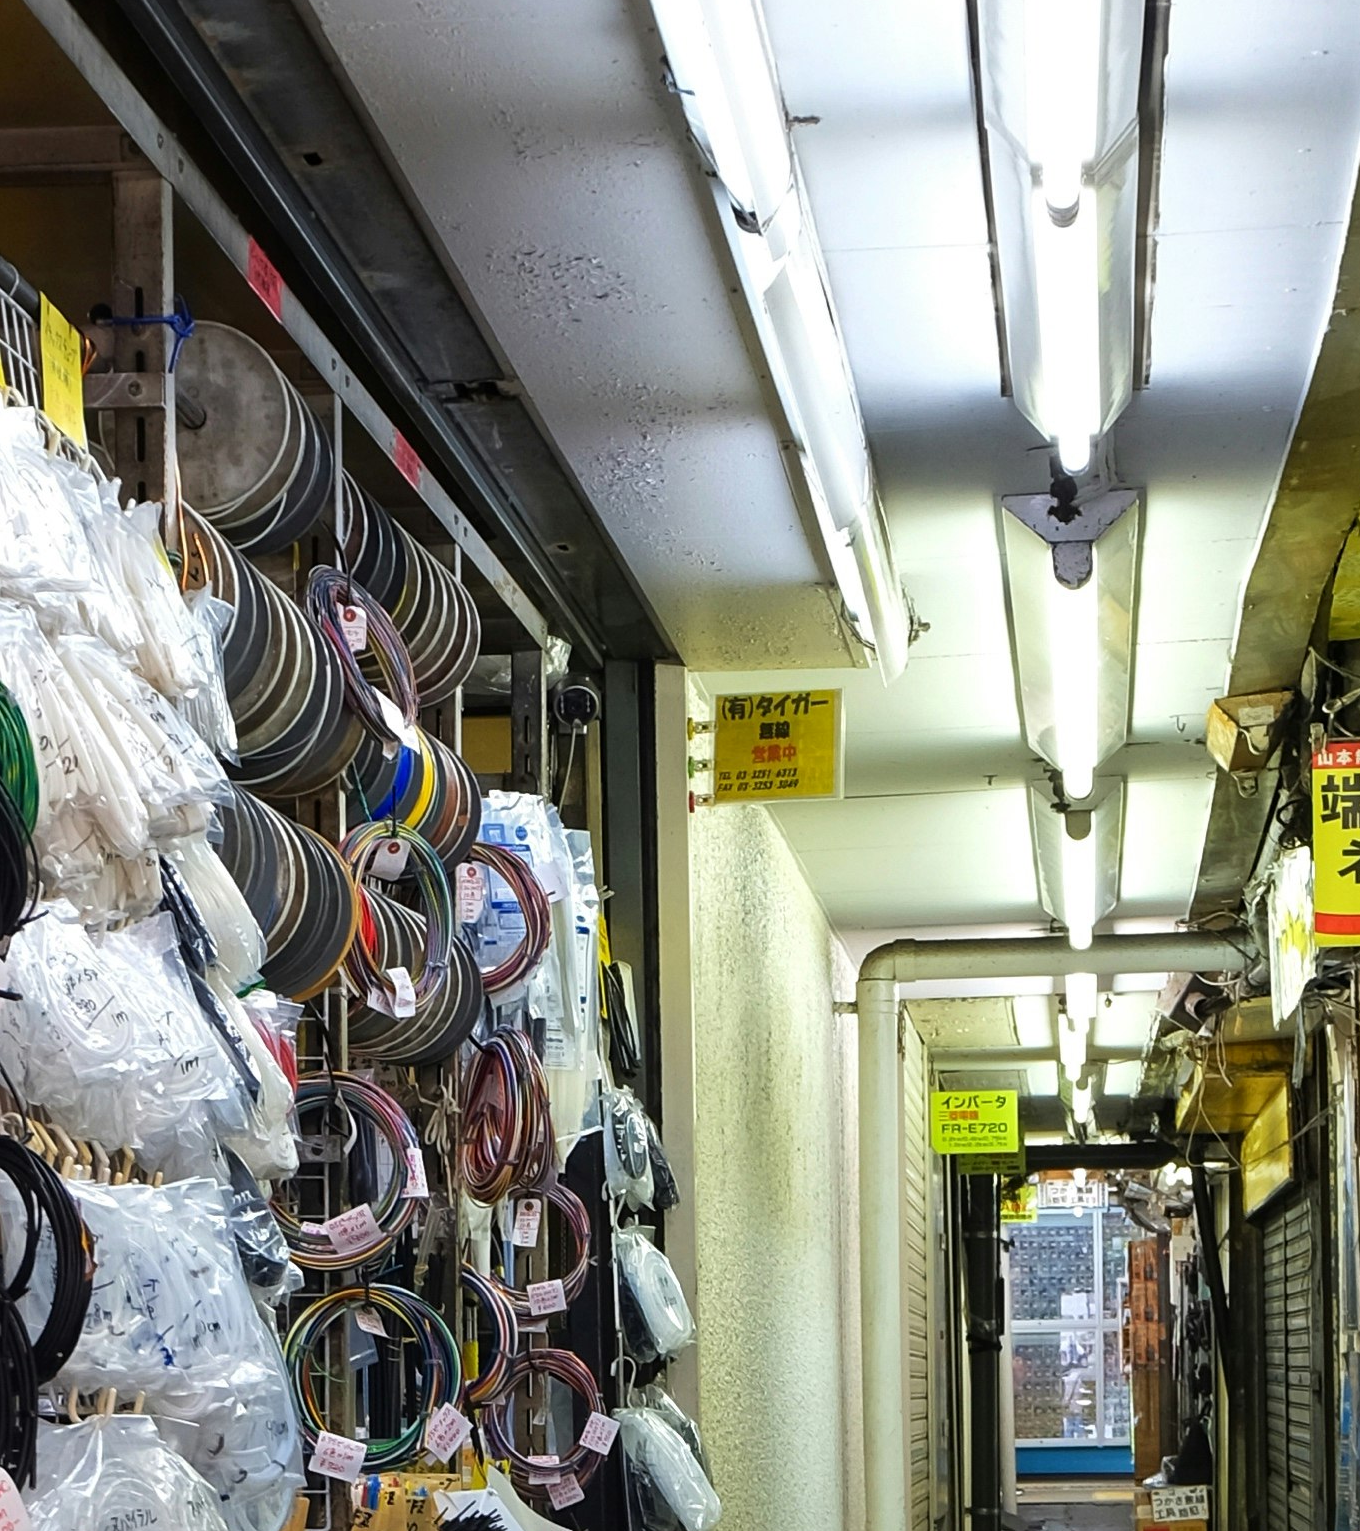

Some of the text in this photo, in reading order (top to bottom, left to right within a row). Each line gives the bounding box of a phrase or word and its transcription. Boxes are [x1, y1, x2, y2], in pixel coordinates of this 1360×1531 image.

[751, 743, 796, 764] 営業中
[941, 1095, 1007, 1109] インバータ
[941, 1122, 1008, 1134] FR-E720
